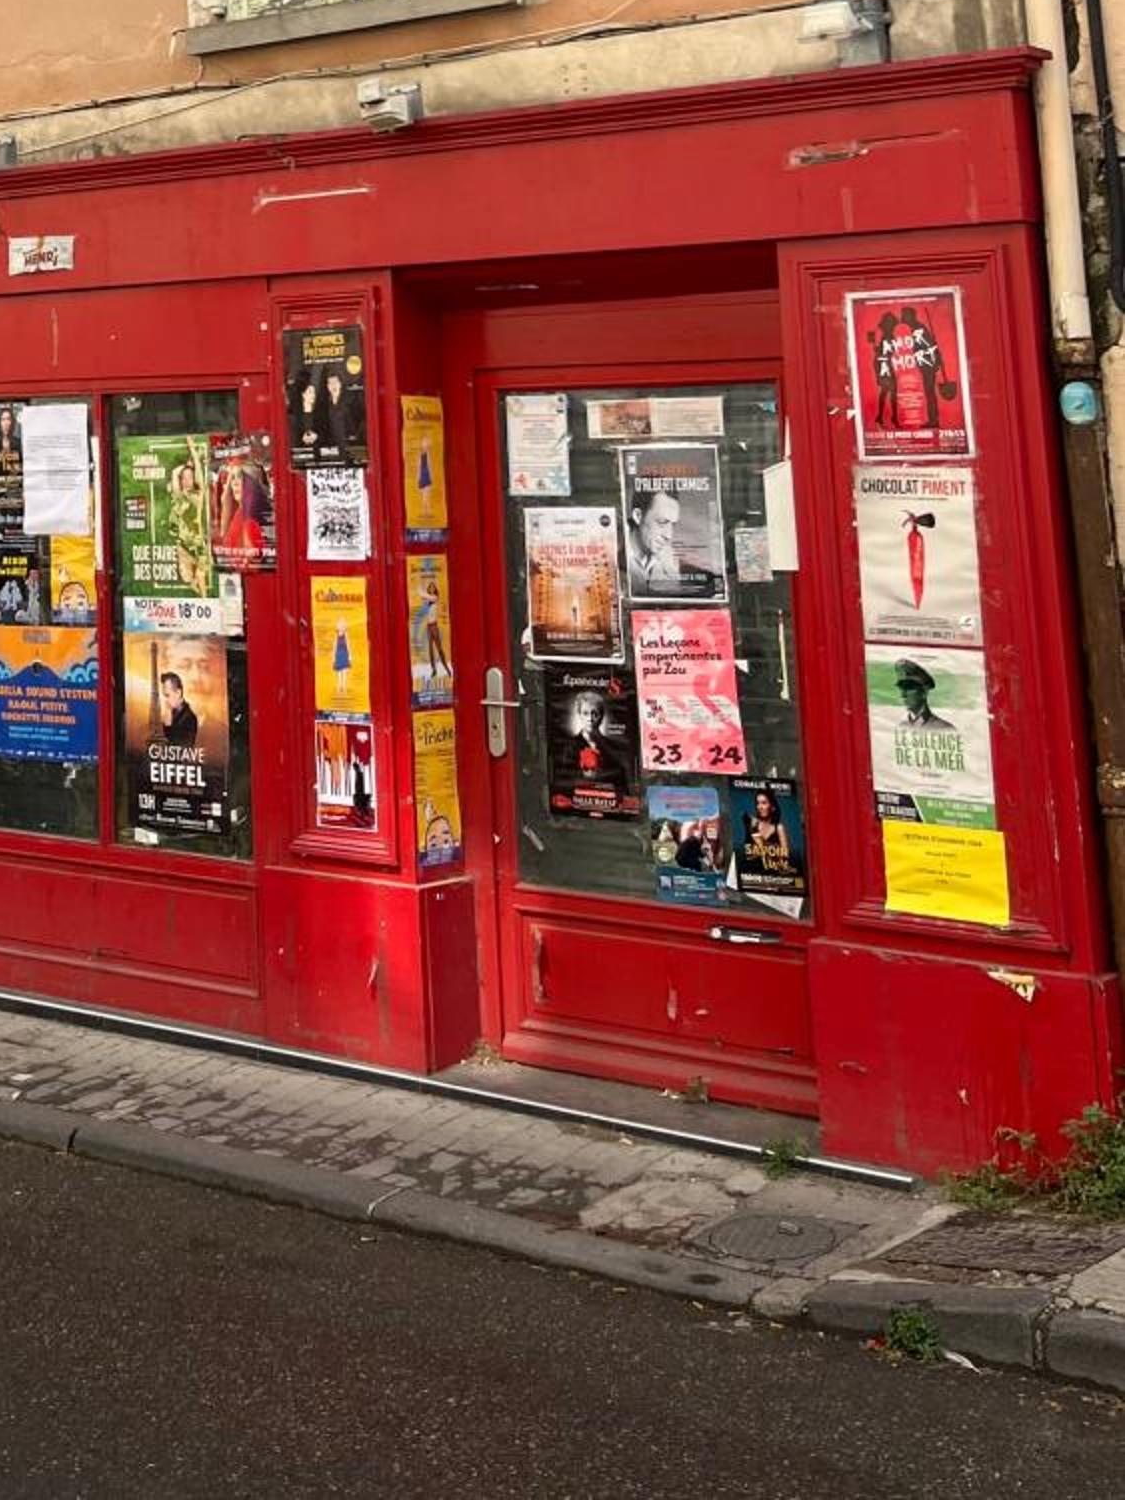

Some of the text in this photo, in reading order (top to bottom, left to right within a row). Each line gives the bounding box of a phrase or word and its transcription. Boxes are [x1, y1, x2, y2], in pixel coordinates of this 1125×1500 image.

[676, 477, 710, 491] CAMUS
[860, 478, 966, 496] CHOCOLAT PIMENT
[132, 545, 178, 561] QUE FAIRE
[134, 563, 177, 581] DES CONS
[661, 636, 700, 652] Leçons
[639, 649, 722, 665] impertinentes
[642, 663, 686, 680] par Zou
[894, 729, 964, 752] LE SILENCE
[148, 743, 205, 765] GUSTAVE
[652, 743, 743, 765] 23 24
[895, 747, 966, 772] DE LA MER
[149, 762, 206, 788] EIFFEL
